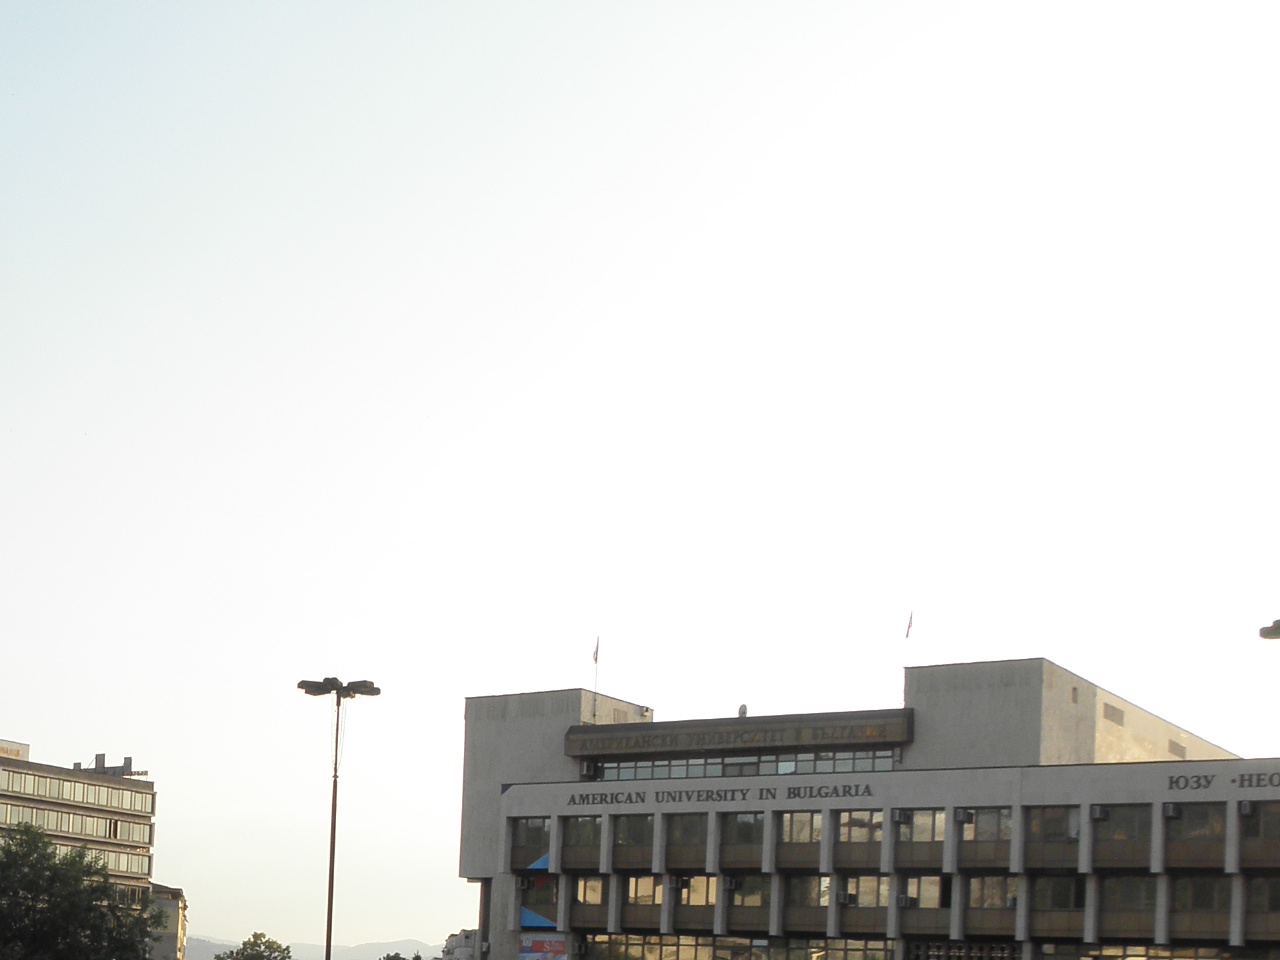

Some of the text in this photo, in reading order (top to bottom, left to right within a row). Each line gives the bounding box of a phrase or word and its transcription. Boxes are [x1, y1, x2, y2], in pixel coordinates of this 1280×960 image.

[1167, 774, 1216, 790] ЮЗУ
[568, 783, 873, 806] AMERICAN UNIVERSITY IN BULGARIA
